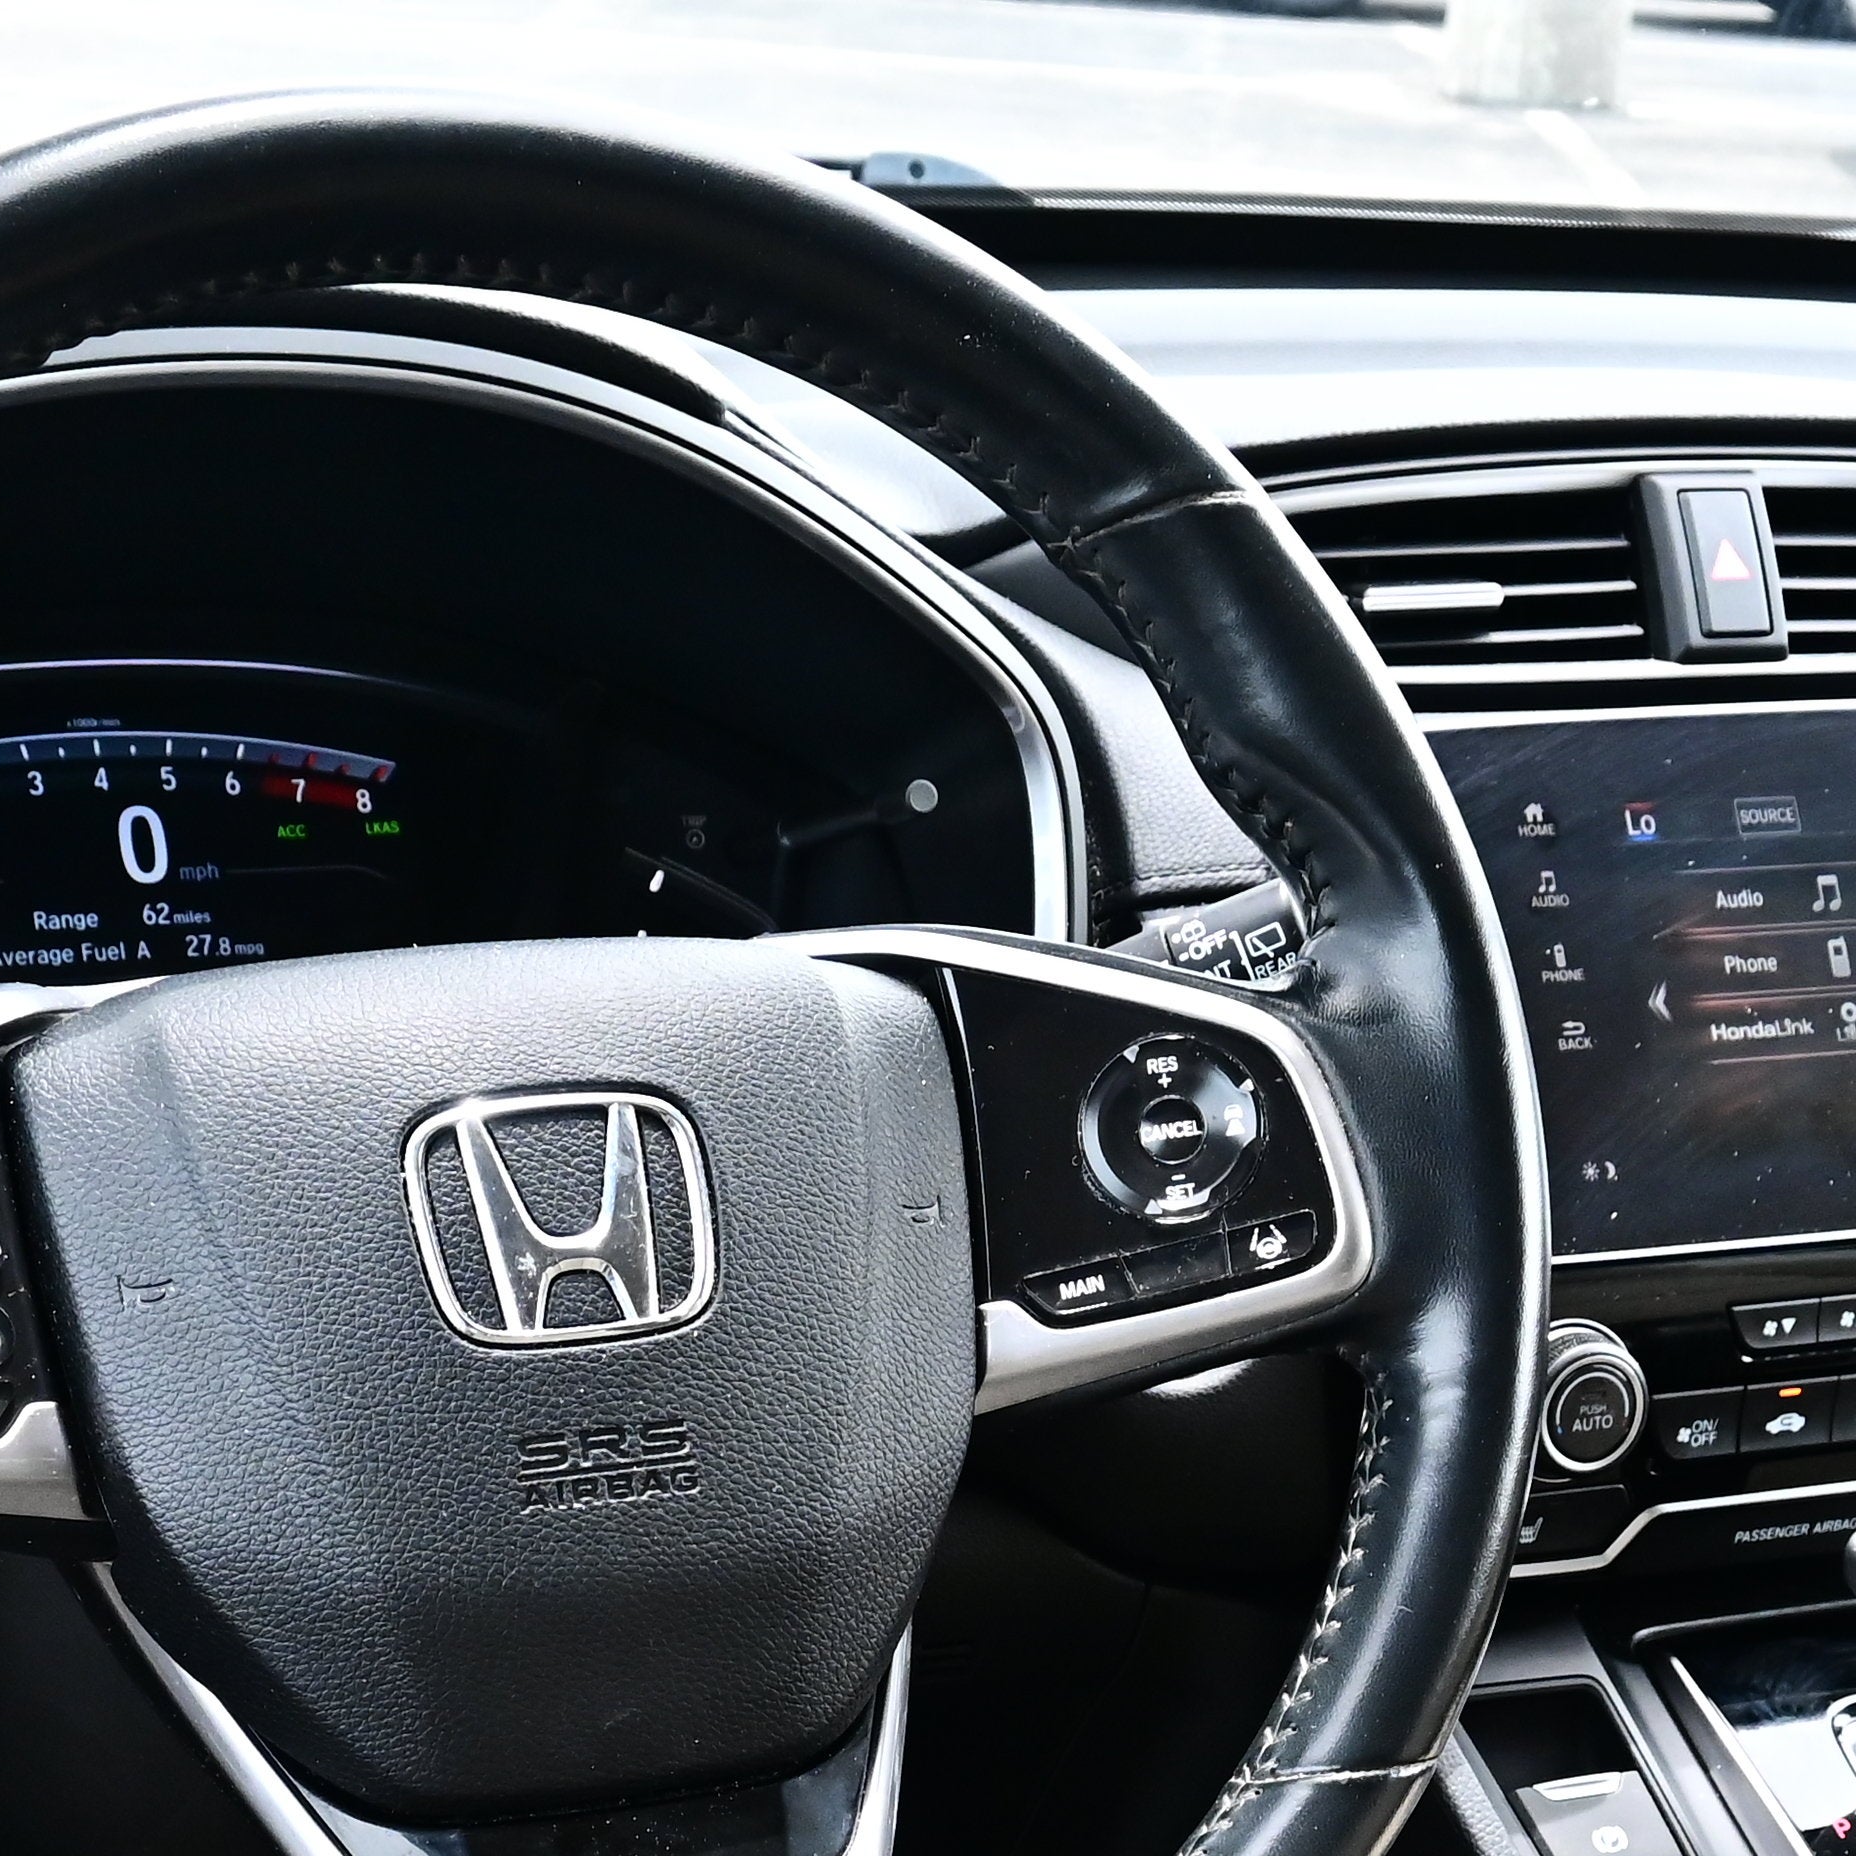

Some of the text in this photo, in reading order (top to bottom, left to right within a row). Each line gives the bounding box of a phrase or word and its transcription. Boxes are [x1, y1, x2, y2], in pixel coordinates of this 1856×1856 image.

[27, 771, 44, 796] 3
[94, 767, 110, 791] 4
[160, 766, 177, 791] 5
[225, 771, 241, 795] 6
[291, 779, 305, 803] 7
[356, 788, 372, 814] 8
[1625, 809, 1656, 835] Lo
[1740, 806, 1796, 824] SOURCE
[277, 823, 306, 838] ACC
[365, 820, 400, 835] LKAS
[1518, 823, 1556, 837] HOME
[118, 805, 220, 884] 0 mph
[1531, 893, 1570, 908] AUDIO
[1715, 889, 1764, 910] Audio
[33, 902, 211, 932] Range 62 miles
[81, 941, 127, 963] Fuel
[137, 940, 152, 960] A
[185, 934, 232, 958] 27.8
[234, 942, 264, 956] mpg
[1542, 968, 1586, 983] PHONE
[1724, 954, 1778, 975] Phone
[1710, 1018, 1815, 1043] HondaLink
[1558, 1037, 1593, 1051] BACK
[1146, 1055, 1179, 1074] RES
[1144, 1119, 1203, 1144] CANCEL
[1165, 1182, 1196, 1201] SET
[1059, 1274, 1106, 1300] MAIN
[1579, 1404, 1607, 1415] PUSH
[1572, 1414, 1614, 1433] AUTO
[517, 1420, 690, 1474] SRS
[1690, 1431, 1718, 1447] OFF
[520, 1469, 702, 1514] AIRBAG
[1733, 1523, 1810, 1545] PASSENGER
[1832, 1816, 1851, 1840] P
